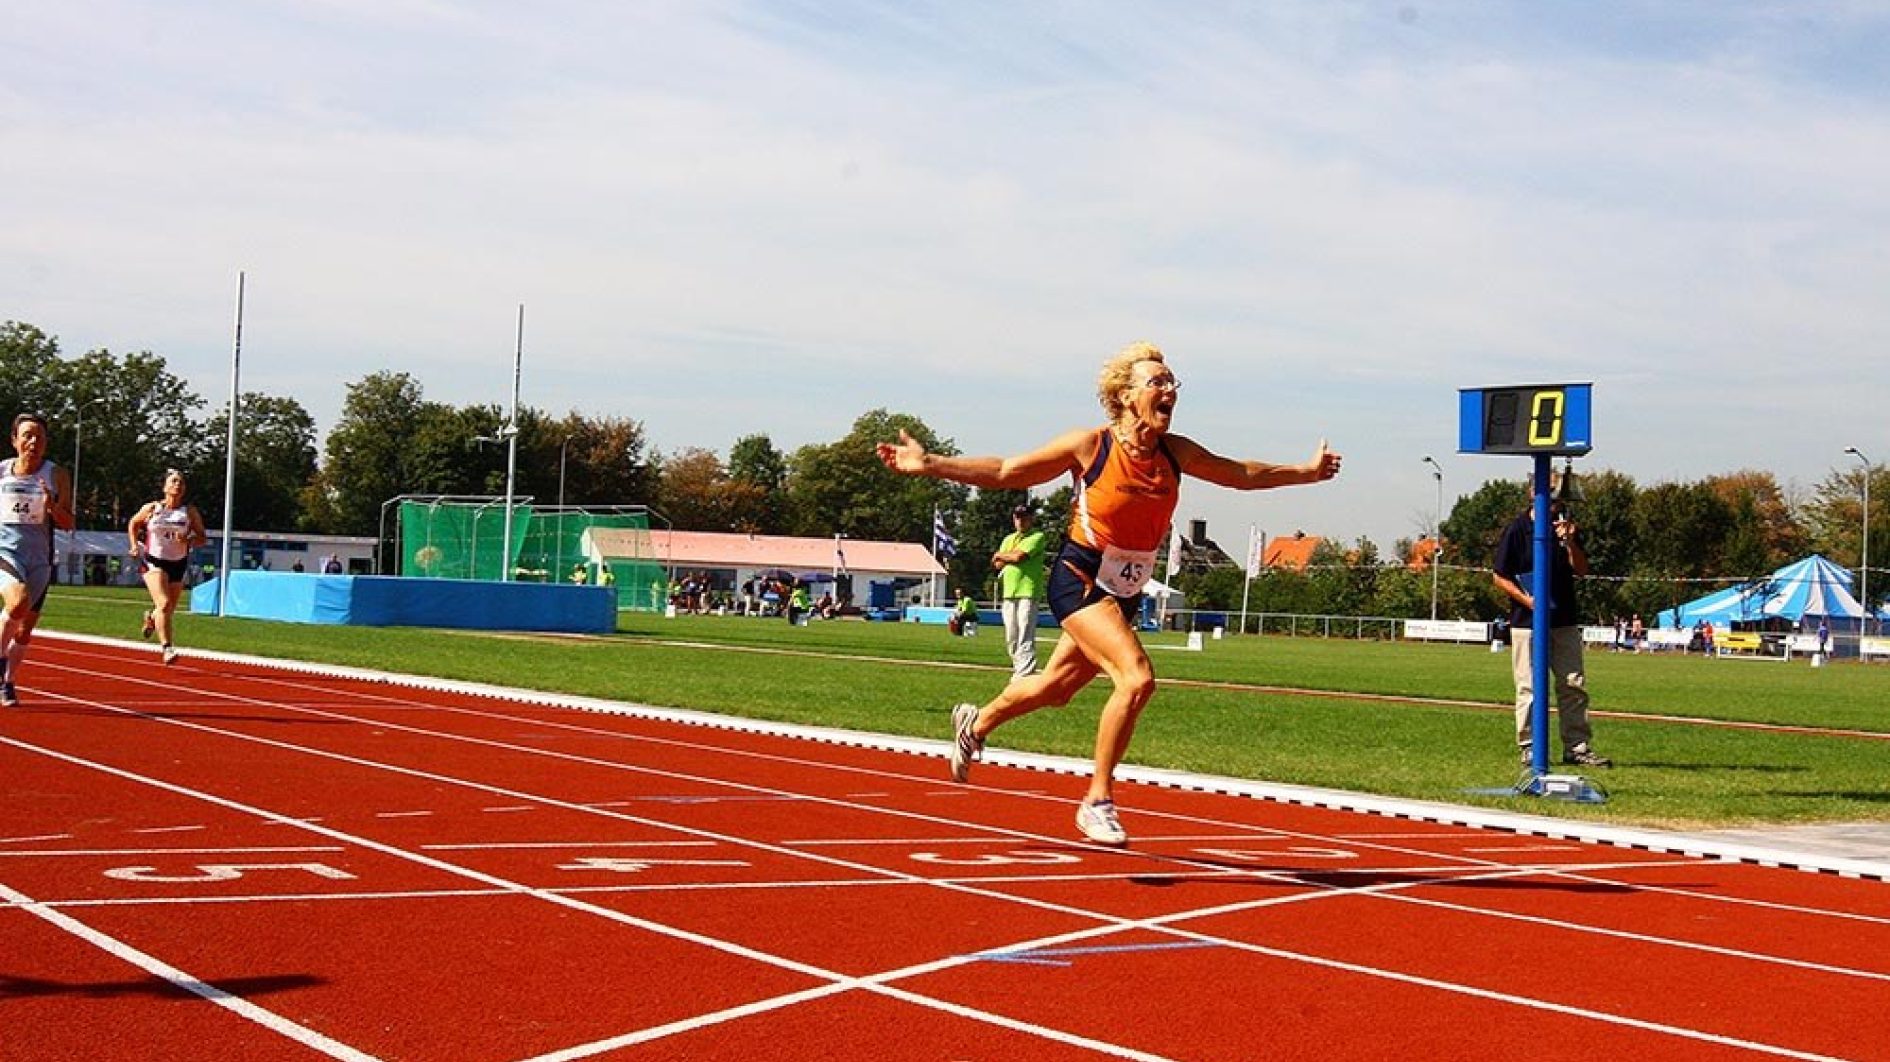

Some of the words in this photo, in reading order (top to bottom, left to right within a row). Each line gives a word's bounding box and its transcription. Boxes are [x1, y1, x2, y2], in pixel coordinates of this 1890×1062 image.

[1528, 391, 1564, 447] 0
[12, 502, 29, 514] 44
[1120, 562, 1144, 583] 43
[909, 851, 1084, 865] 3
[102, 863, 359, 882] 5
